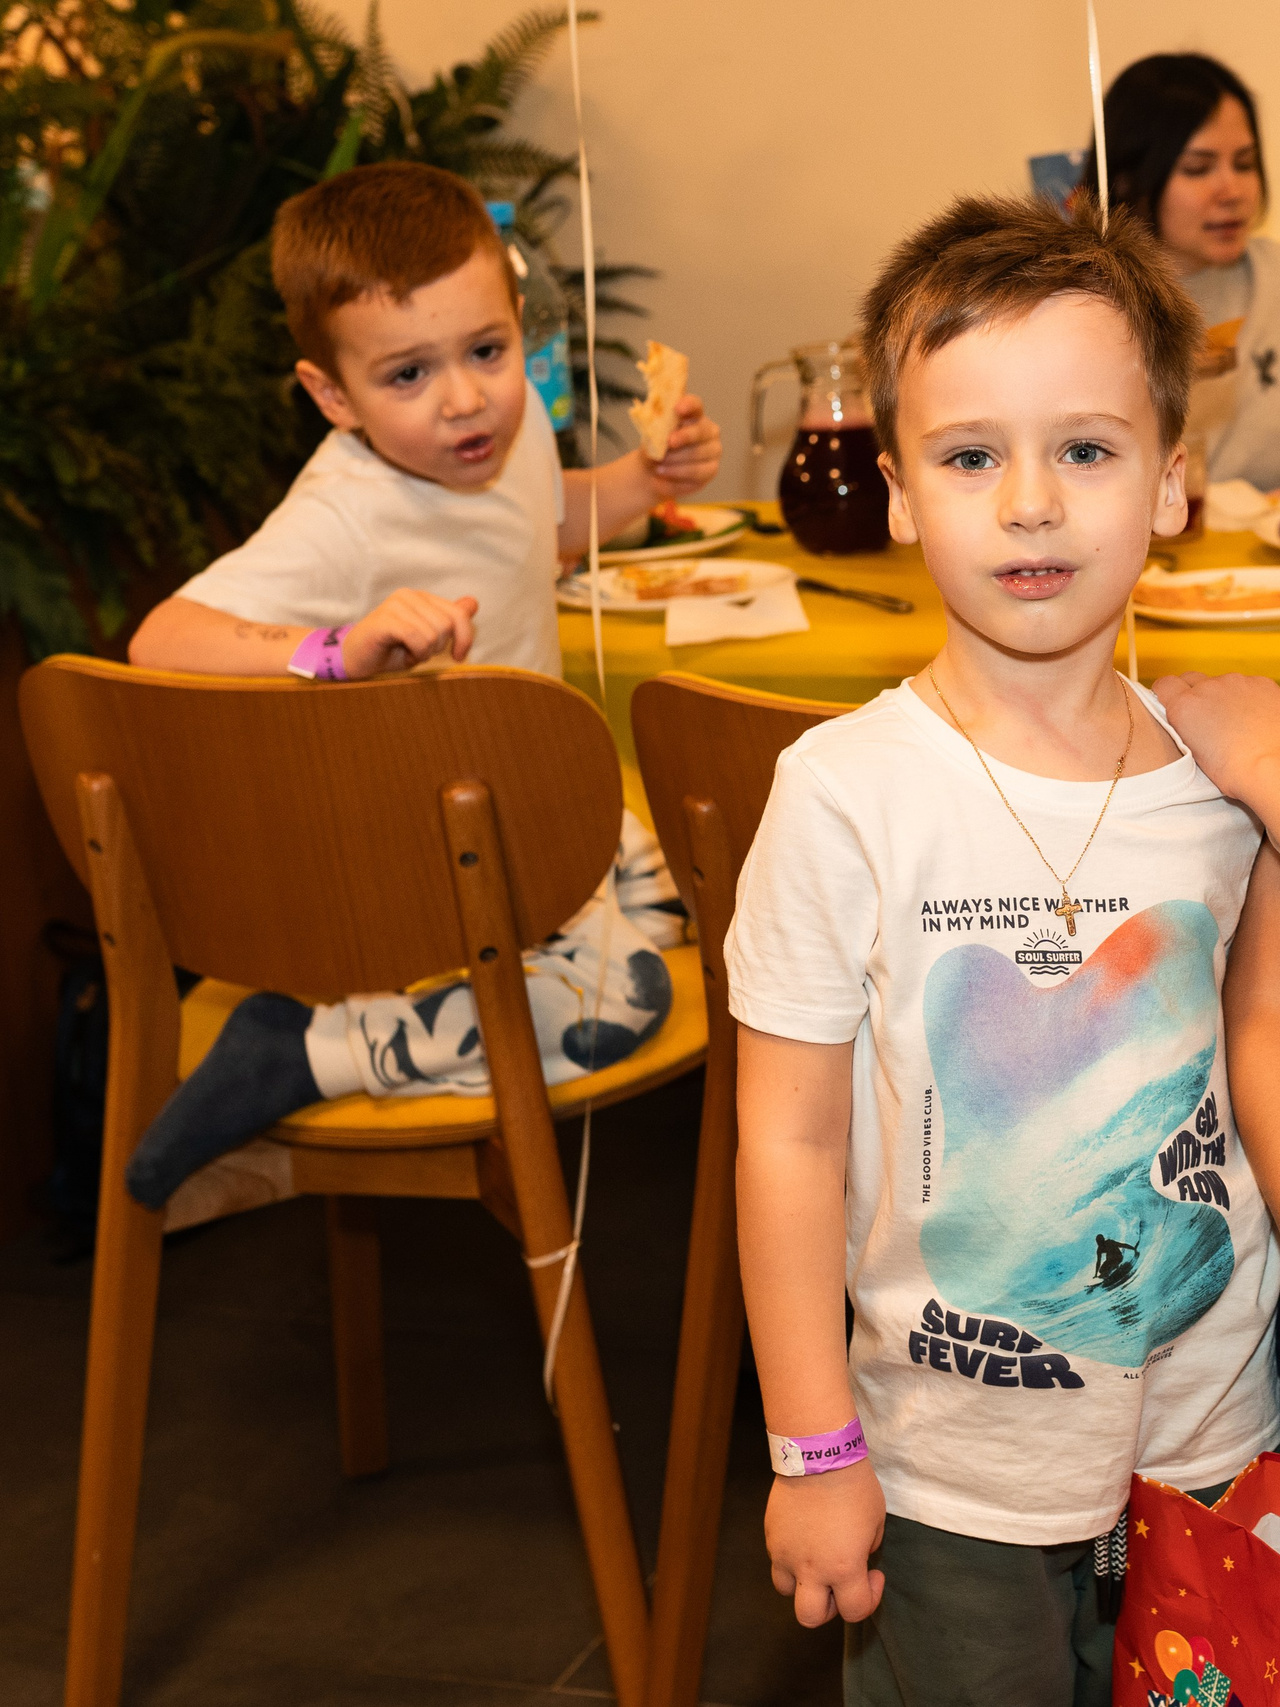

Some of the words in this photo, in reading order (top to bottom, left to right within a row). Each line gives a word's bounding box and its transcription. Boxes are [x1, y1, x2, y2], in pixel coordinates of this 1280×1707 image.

[921, 898, 993, 915] ALWAYS
[998, 897, 1041, 912] NICE
[1044, 897, 1130, 914] WATHER
[922, 917, 942, 932] IN
[947, 915, 974, 931] MY
[980, 914, 1030, 930] MIND
[1017, 952, 1045, 962] SOUL
[1046, 952, 1080, 962] SURFER
[924, 1084, 933, 1115] CLUB.
[923, 1117, 932, 1147] VIBES
[922, 1149, 931, 1181] GOOD
[1158, 1130, 1202, 1187] WITH
[1202, 1132, 1226, 1167] THE
[922, 1184, 931, 1204] THE
[1176, 1169, 1230, 1211] FLOW
[920, 1298, 1043, 1353] SURF
[908, 1330, 1086, 1389] FEVER
